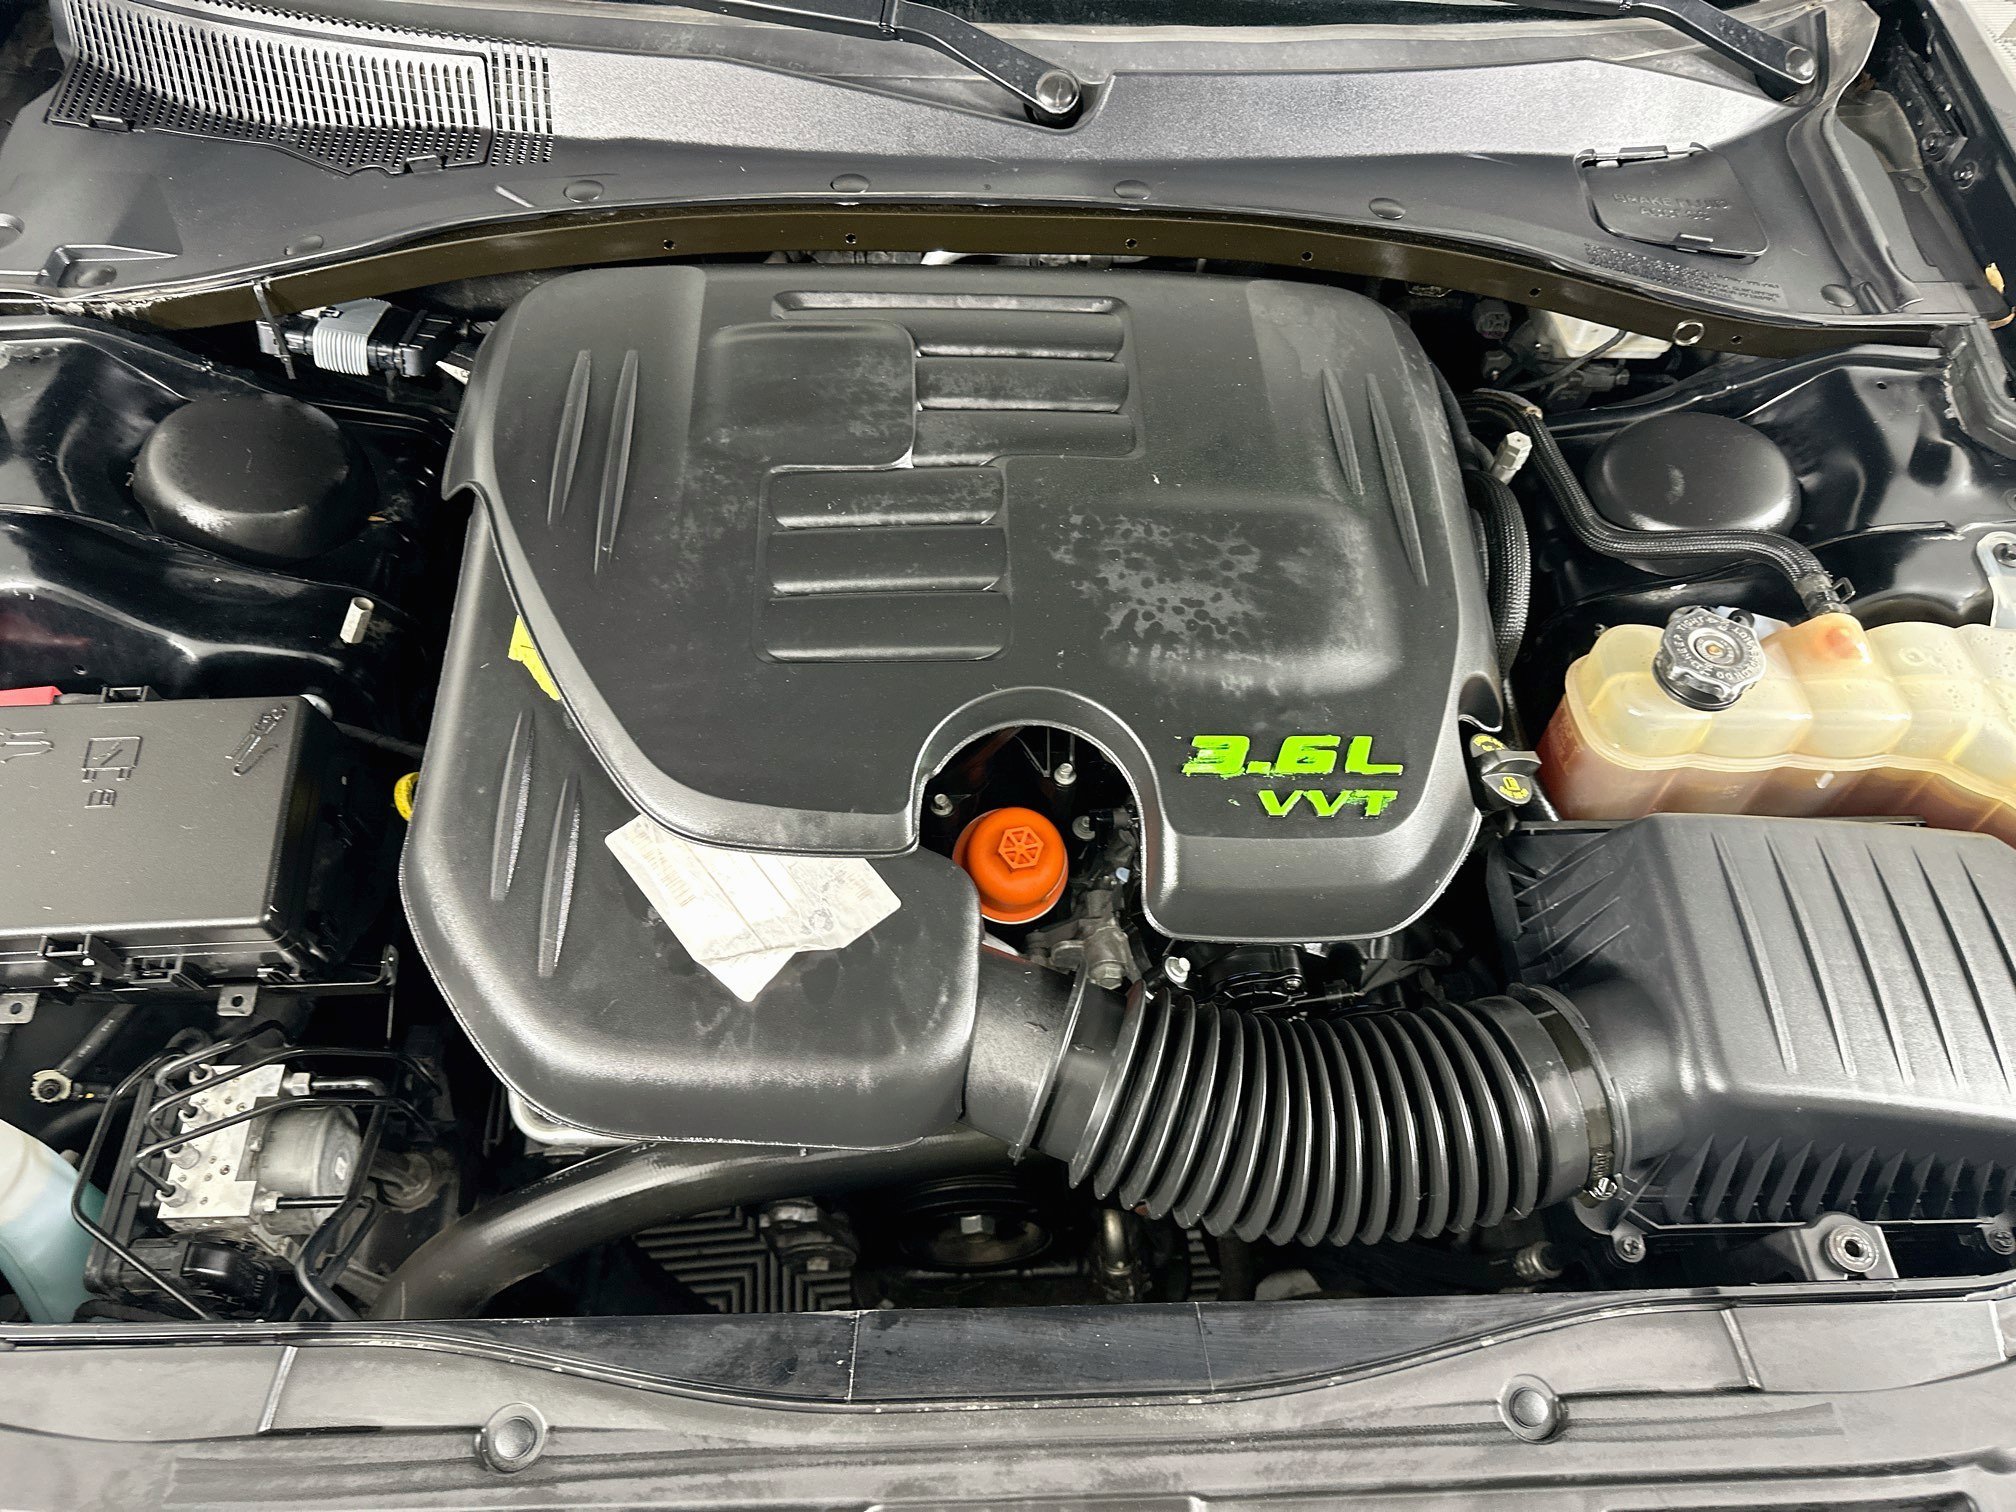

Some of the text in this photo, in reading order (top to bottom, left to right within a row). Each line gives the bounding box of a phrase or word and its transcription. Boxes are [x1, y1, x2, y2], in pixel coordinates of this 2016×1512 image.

[1612, 193, 1673, 206] BRAKE
[1676, 617, 1705, 631] TIGHT
[1182, 735, 1404, 779] 3.6L
[1258, 789, 1399, 818] VVT
